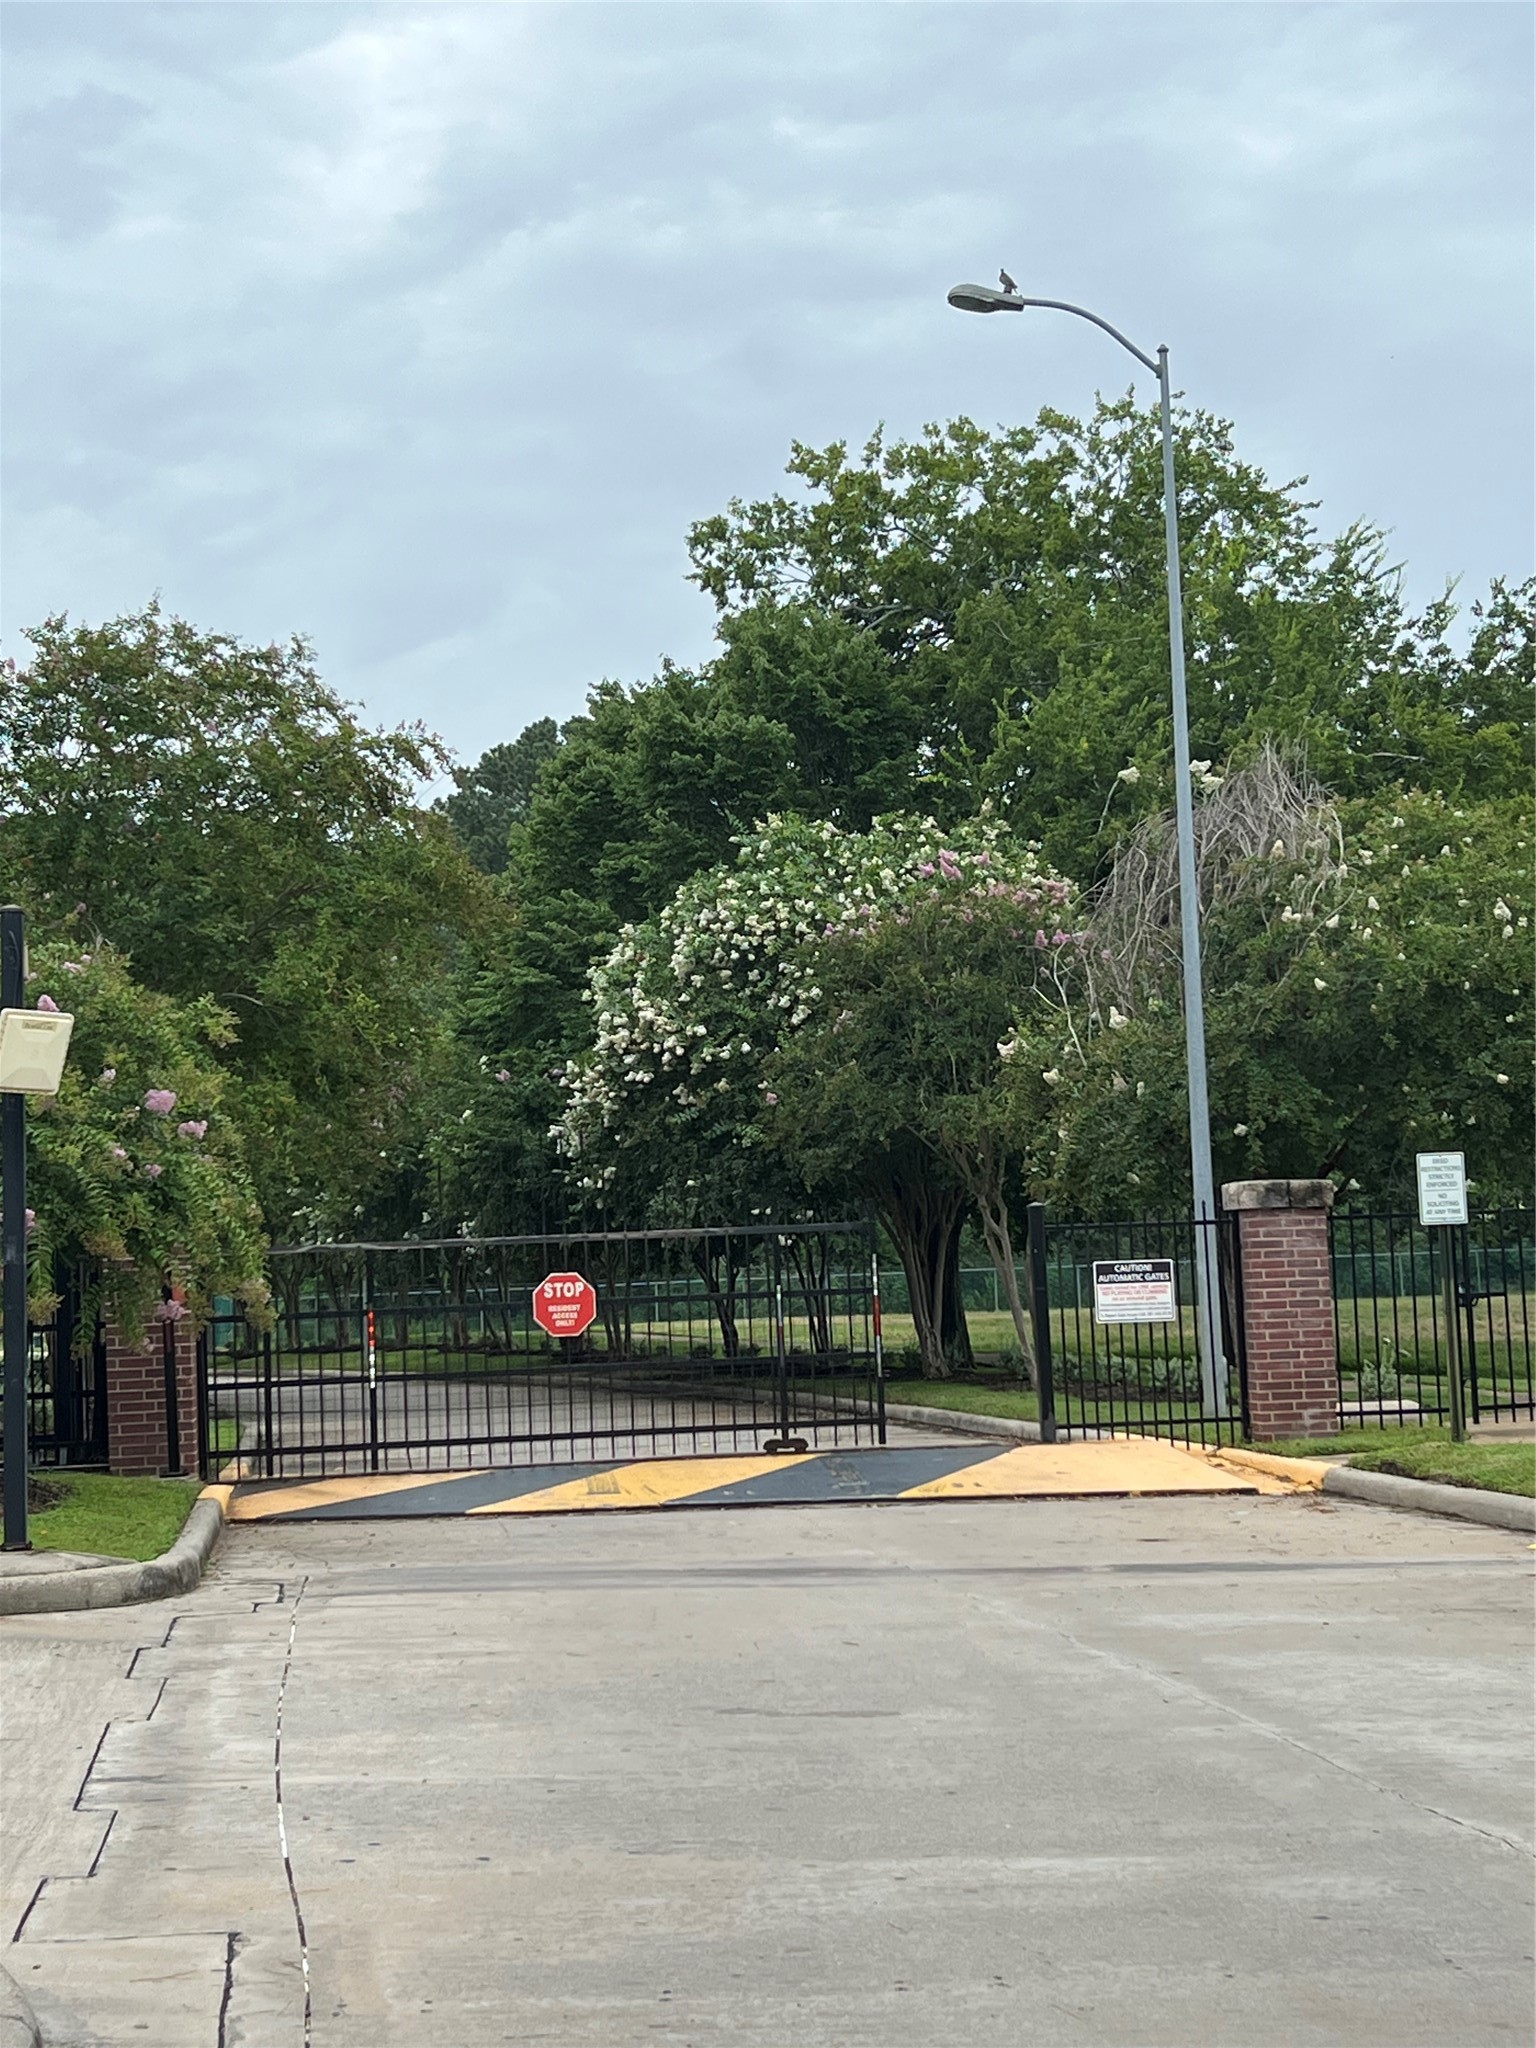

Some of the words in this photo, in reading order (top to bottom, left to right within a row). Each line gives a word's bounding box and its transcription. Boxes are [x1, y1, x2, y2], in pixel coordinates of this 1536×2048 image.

[1114, 1263, 1152, 1272] CAUTION!
[1098, 1274, 1143, 1282] AUTOMATIC
[1145, 1272, 1169, 1280] GATES
[543, 1282, 584, 1298] STOP
[548, 1304, 581, 1312] RESIDENT
